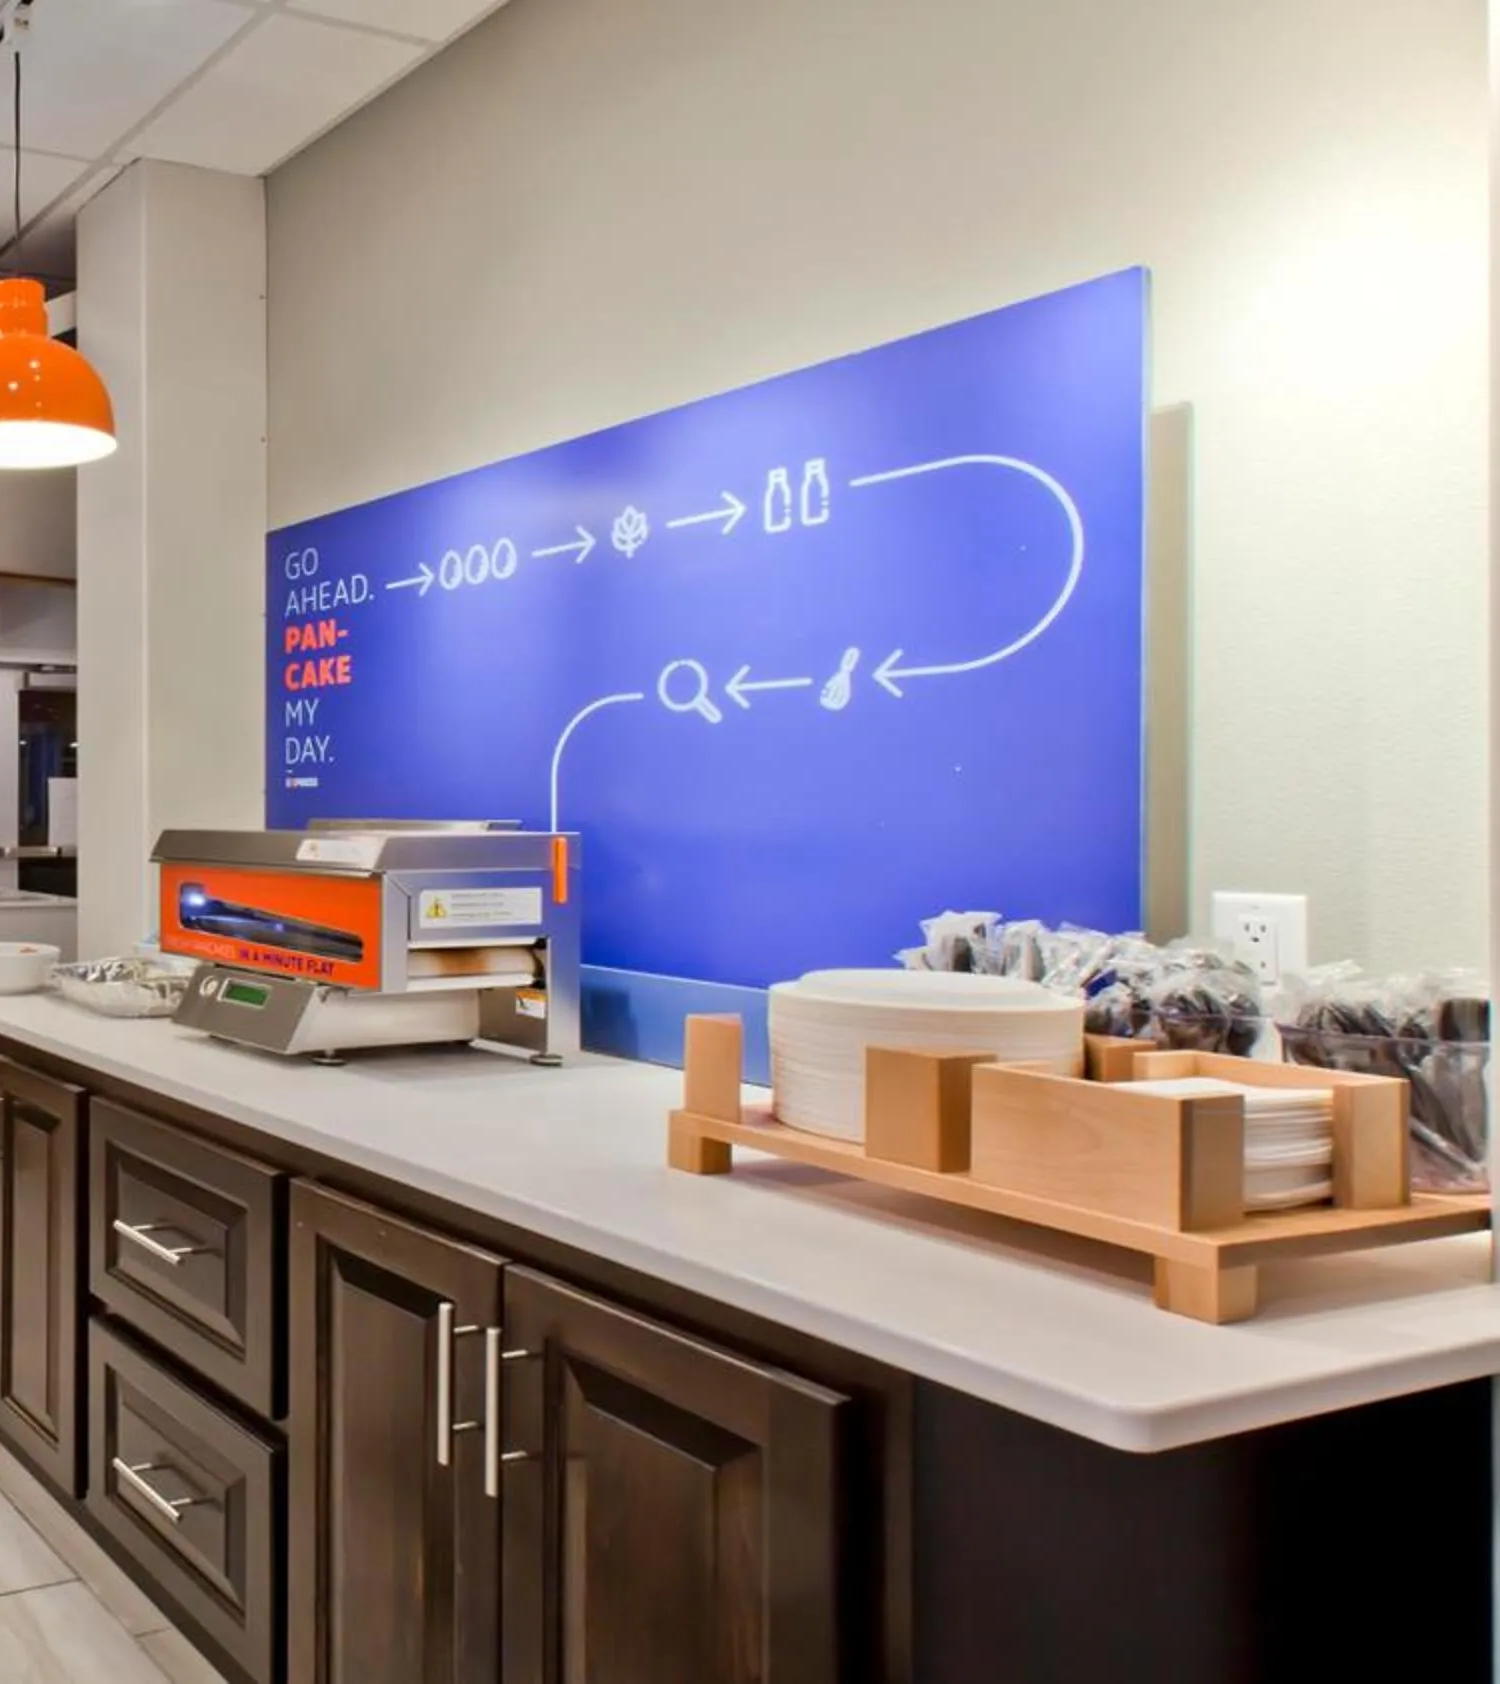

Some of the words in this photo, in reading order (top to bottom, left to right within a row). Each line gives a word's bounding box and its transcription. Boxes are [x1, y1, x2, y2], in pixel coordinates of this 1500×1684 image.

[285, 547, 319, 580] GO
[284, 573, 375, 618] AHEAD.
[285, 618, 348, 654] PAN-
[284, 655, 352, 691] CAKE
[285, 698, 320, 728] MY
[285, 735, 335, 765] DAY.
[307, 959, 335, 976] FLAT
